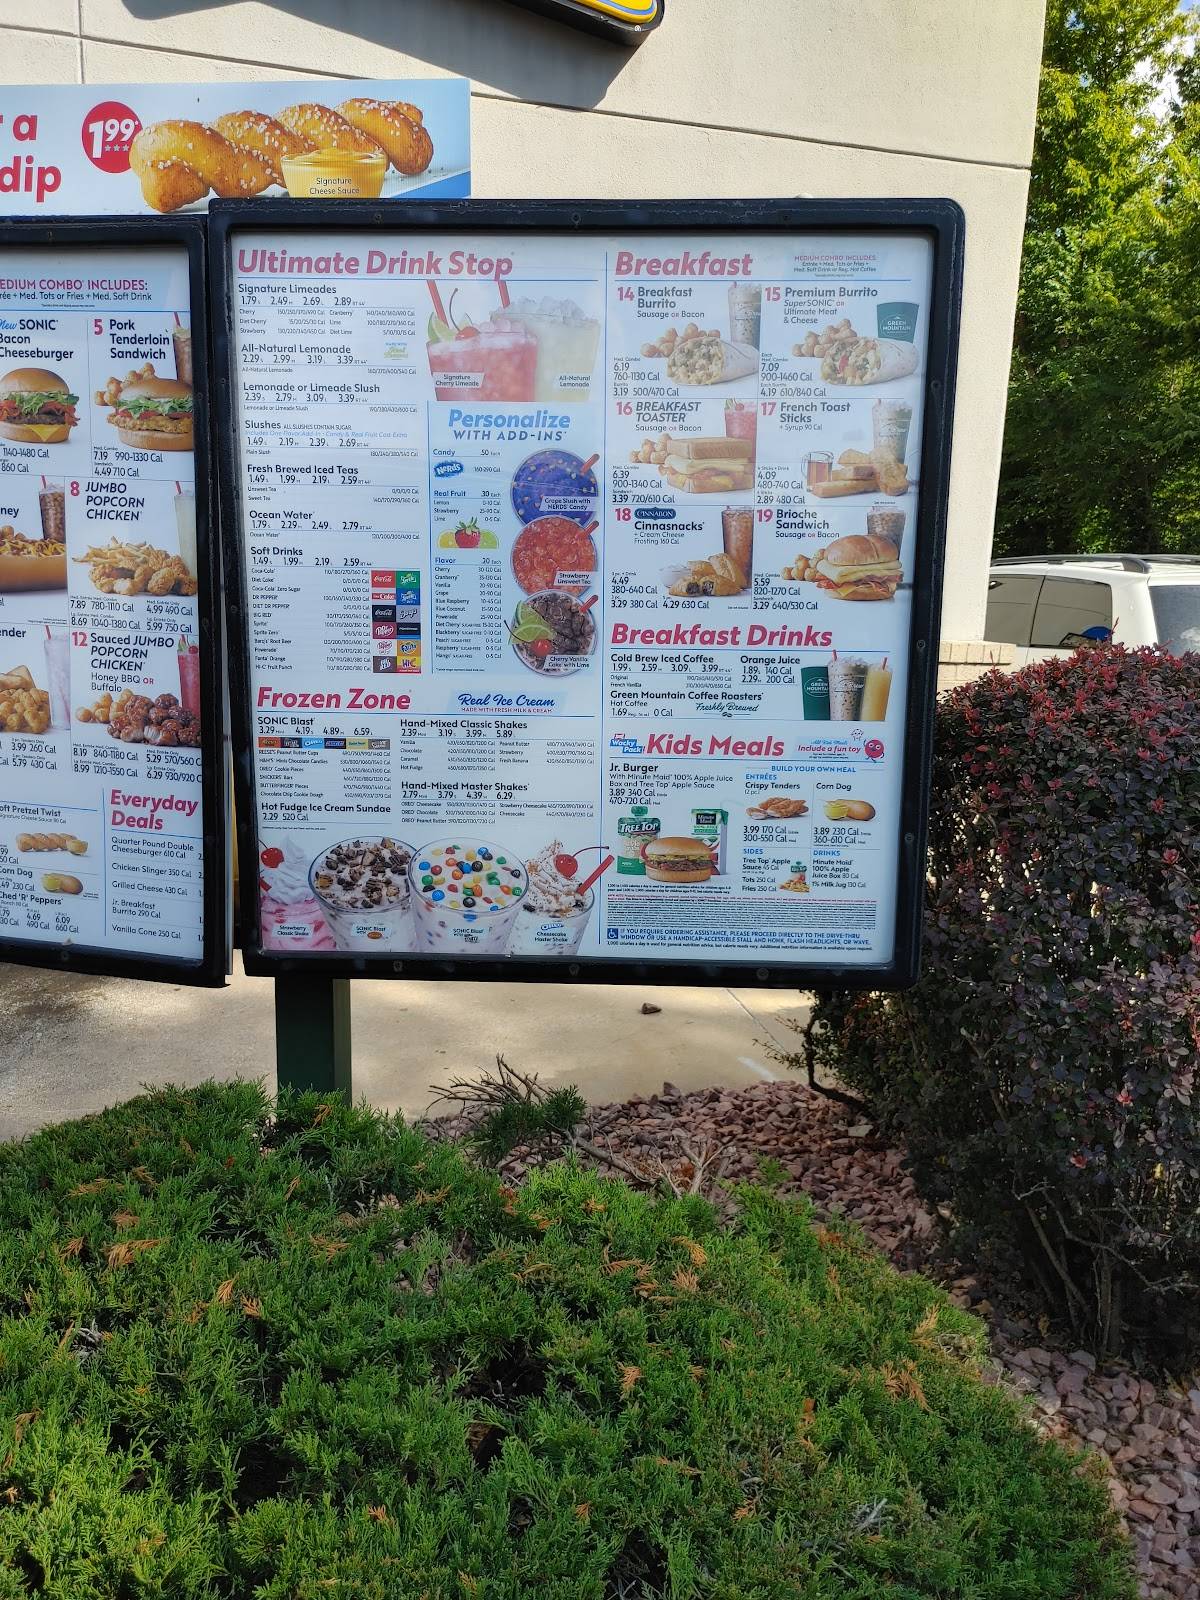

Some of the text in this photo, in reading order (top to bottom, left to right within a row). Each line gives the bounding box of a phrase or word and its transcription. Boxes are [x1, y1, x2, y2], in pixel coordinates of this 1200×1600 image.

[13, 115, 37, 141] a
[316, 178, 351, 186] Signature
[239, 250, 512, 281] Ultimate Drink Stop
[616, 252, 753, 275] Breakfast
[39, 280, 148, 290] COMBO INCLUDES:
[238, 284, 336, 294] Signature Limeades
[618, 287, 692, 301] 14 Breakfast
[765, 287, 878, 301] 15 Premium Burrito
[241, 296, 288, 305] 1.79 2.49
[638, 299, 676, 308] Burrito
[637, 311, 669, 319] Sausage
[19, 320, 55, 330] SONIC
[94, 319, 135, 335] 5 Pork
[110, 335, 169, 345] Tenderloin
[111, 348, 166, 359] Sandwich
[241, 345, 351, 353] All-Natural Lemonade
[243, 355, 259, 363] 2.29
[614, 363, 629, 371] 6.19
[762, 363, 779, 371] 7.09
[244, 383, 294, 391] Lemonade
[311, 384, 351, 392] Limeade
[614, 388, 628, 396] 3.19
[617, 402, 701, 415] 16 BREAKFAST
[762, 402, 850, 415] 17 French Toast
[449, 409, 570, 428] Personalize
[637, 413, 685, 422] TOASTER
[780, 414, 811, 423] Sticks
[245, 420, 281, 429] Slushes
[455, 431, 563, 441] WITH ADD-INS
[94, 451, 108, 461] 7.19
[247, 464, 358, 474] Fresh Brewed Iced Teas
[249, 475, 265, 483] 1.49
[71, 481, 127, 496] 8 JUMBO
[86, 496, 144, 507] POPCORN
[87, 510, 140, 520] CHICKEN
[250, 511, 313, 520] Ocean Water
[615, 508, 631, 521] 18
[757, 509, 817, 522] 19 Brioche
[635, 521, 702, 531] Cinnasnacks
[776, 520, 829, 529] Sandwich
[251, 547, 303, 556] Soft Drinks
[754, 578, 770, 586] 5.59
[71, 600, 86, 609] 7.89
[147, 605, 163, 614] 4.99
[72, 632, 174, 647] 12 Sauced JUMBO
[612, 624, 832, 648] Breakfast Drinks
[91, 647, 148, 658] POPCORN
[611, 654, 632, 662] Cold
[683, 655, 713, 663] Coffee
[740, 656, 800, 666] Orange Juice
[91, 659, 143, 671] CHICKEN
[92, 673, 140, 685] Honey BBQ
[92, 683, 122, 693] Buffalo
[257, 687, 410, 709] Frozen Zone
[611, 691, 761, 700] Green Mountain Coffee Roasters
[516, 695, 555, 707] Cream
[258, 717, 288, 725] SONIC
[401, 719, 527, 729] Hand-Mixed Classic Shakes
[259, 726, 274, 734] 3.29
[647, 734, 784, 756] Kids Meals
[73, 748, 87, 756] 8.19
[610, 763, 658, 773] Jr. Burger
[402, 782, 458, 790] Hand-Mixed
[495, 783, 528, 791] Shakes
[836, 783, 851, 791] Dog
[111, 790, 198, 816] Everyday
[262, 803, 390, 813] Hot Fudge Ice Cream Sundae
[12, 806, 61, 816] Pretzel Twist
[112, 811, 163, 830] Deals
[112, 837, 193, 851] Quarter Pound Double
[112, 845, 161, 857] Cheeseburger
[17, 868, 32, 877] Dog
[112, 863, 166, 875] Chicken Slinger
[112, 881, 163, 893] Grilled Cheese
[30, 895, 62, 905] Peppers
[112, 925, 136, 934] Vanilla
